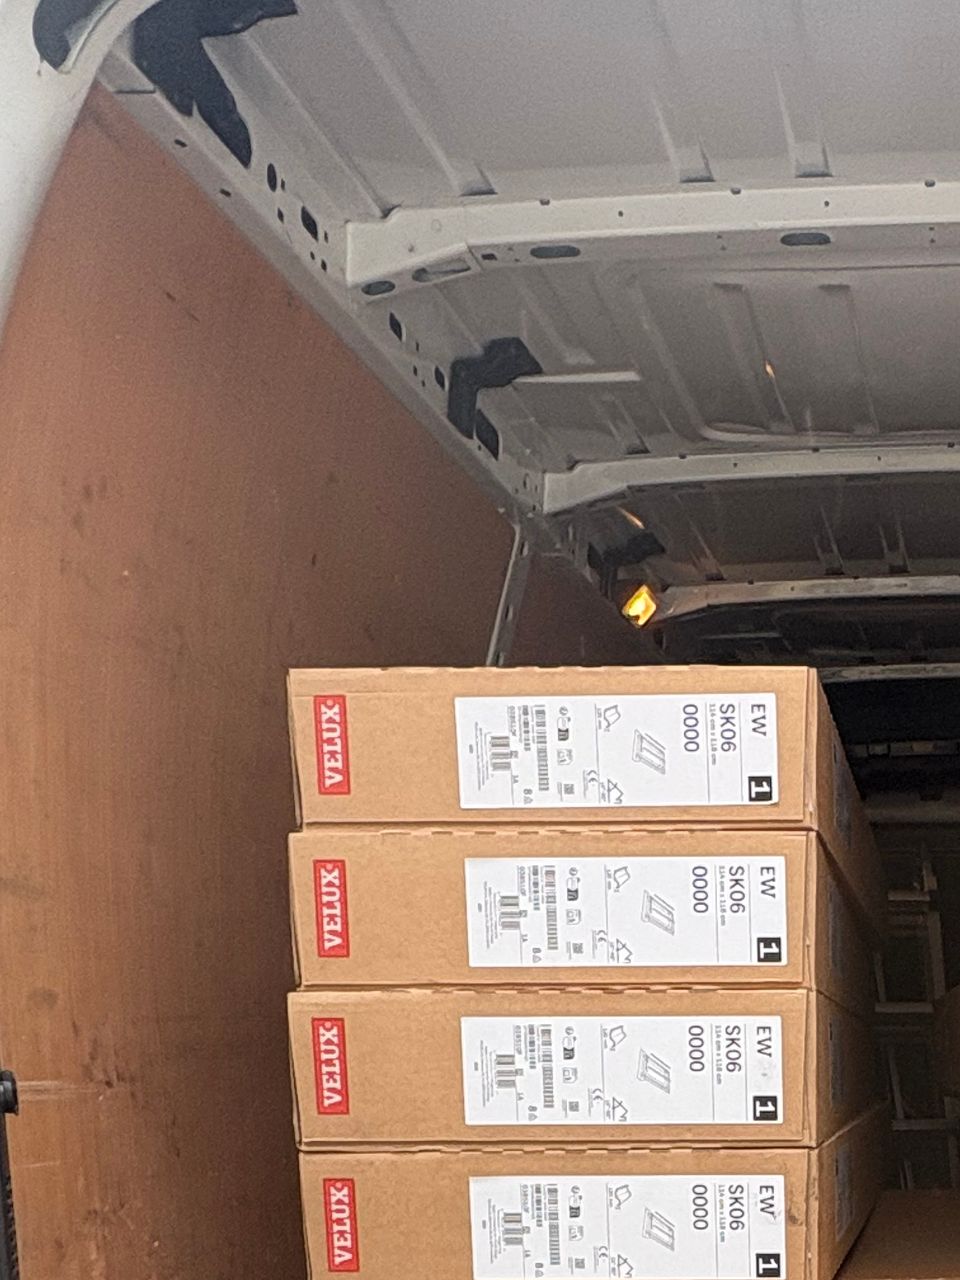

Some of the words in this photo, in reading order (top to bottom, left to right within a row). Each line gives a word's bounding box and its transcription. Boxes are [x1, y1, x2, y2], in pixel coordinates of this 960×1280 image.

[683, 703, 700, 753] 0000
[719, 703, 737, 753] SK06
[751, 703, 767, 737] EW
[320, 702, 344, 789] VELUX
[691, 865, 709, 914] 0000
[729, 865, 746, 914] SK06
[760, 866, 776, 899] EW
[320, 867, 343, 951] VELUX
[688, 1025, 705, 1072] 0000
[725, 1025, 742, 1073] SK06
[756, 1025, 772, 1058] EW
[319, 1025, 342, 1108] VELUX
[692, 1184, 709, 1231] 0000
[728, 1184, 745, 1231] SK06
[759, 1185, 775, 1215] EW
[330, 1185, 353, 1266] VELUX
